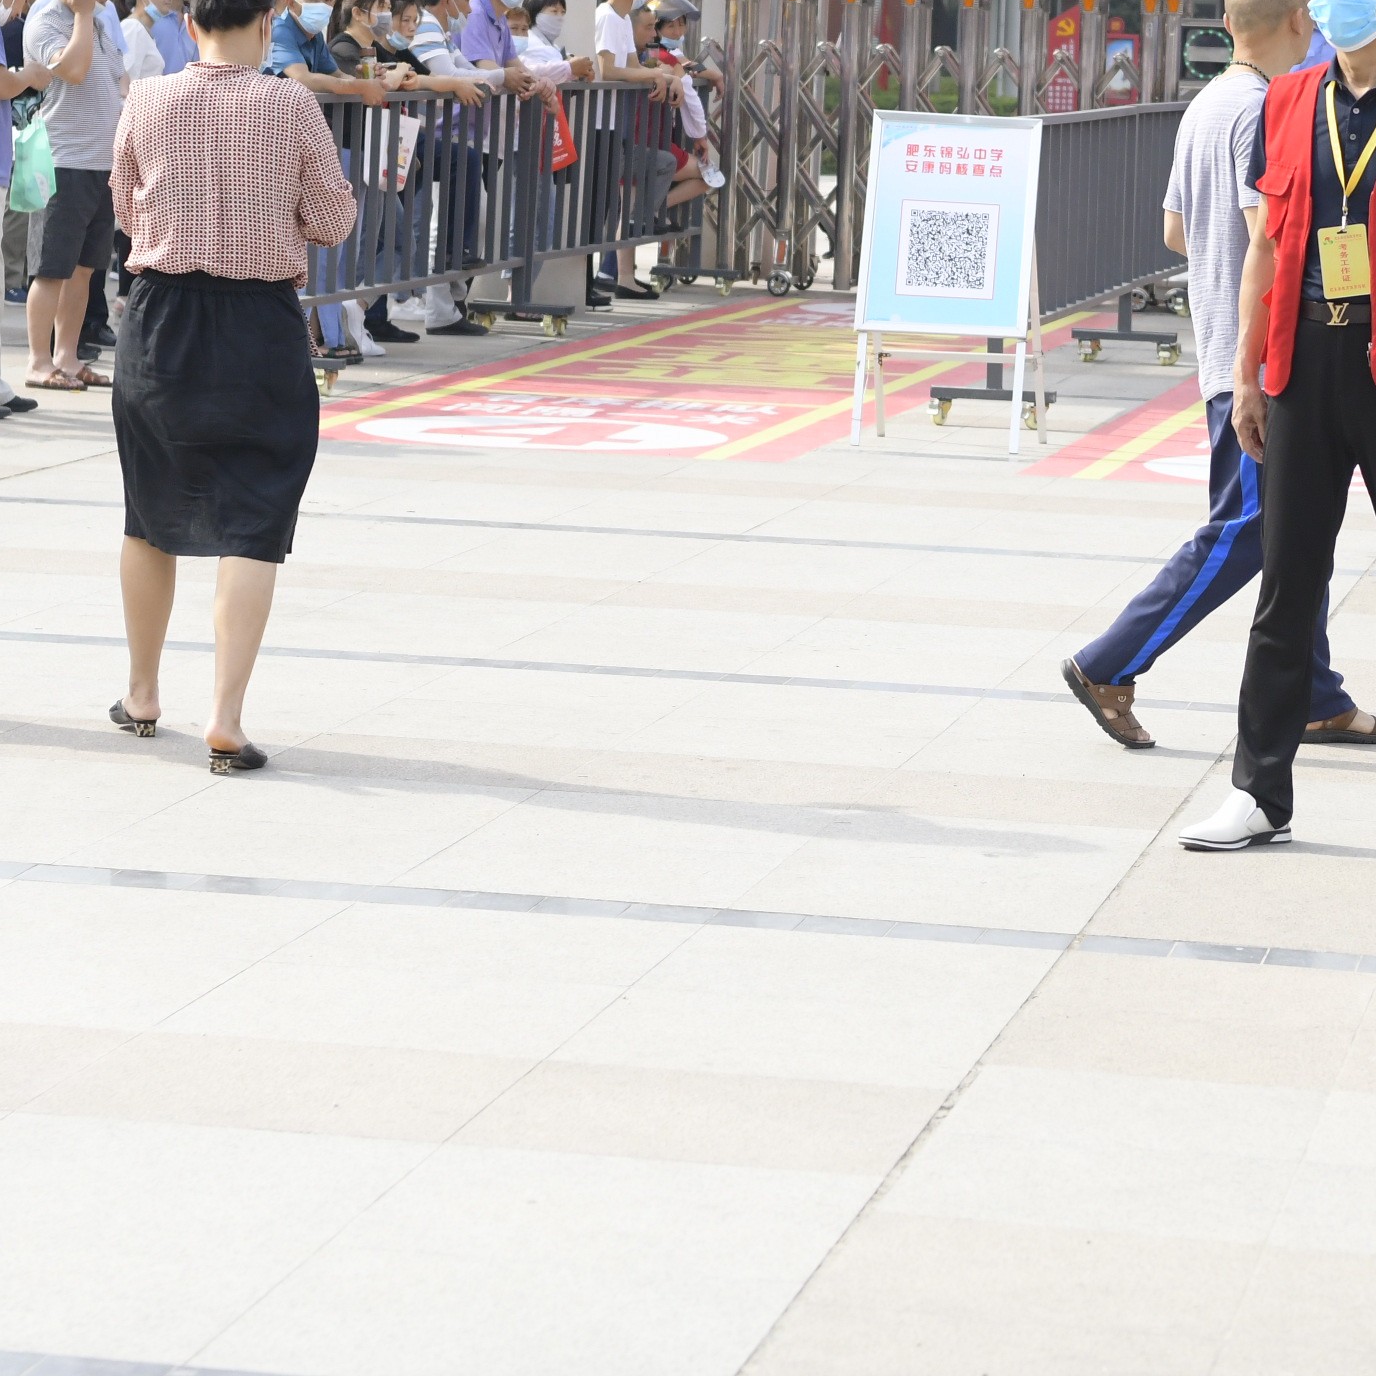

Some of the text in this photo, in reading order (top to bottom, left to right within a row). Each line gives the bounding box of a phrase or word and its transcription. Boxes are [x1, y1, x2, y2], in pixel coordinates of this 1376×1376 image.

[906, 143, 1004, 162] 肥东锦弘中学
[905, 160, 1003, 178] 安康码核查点
